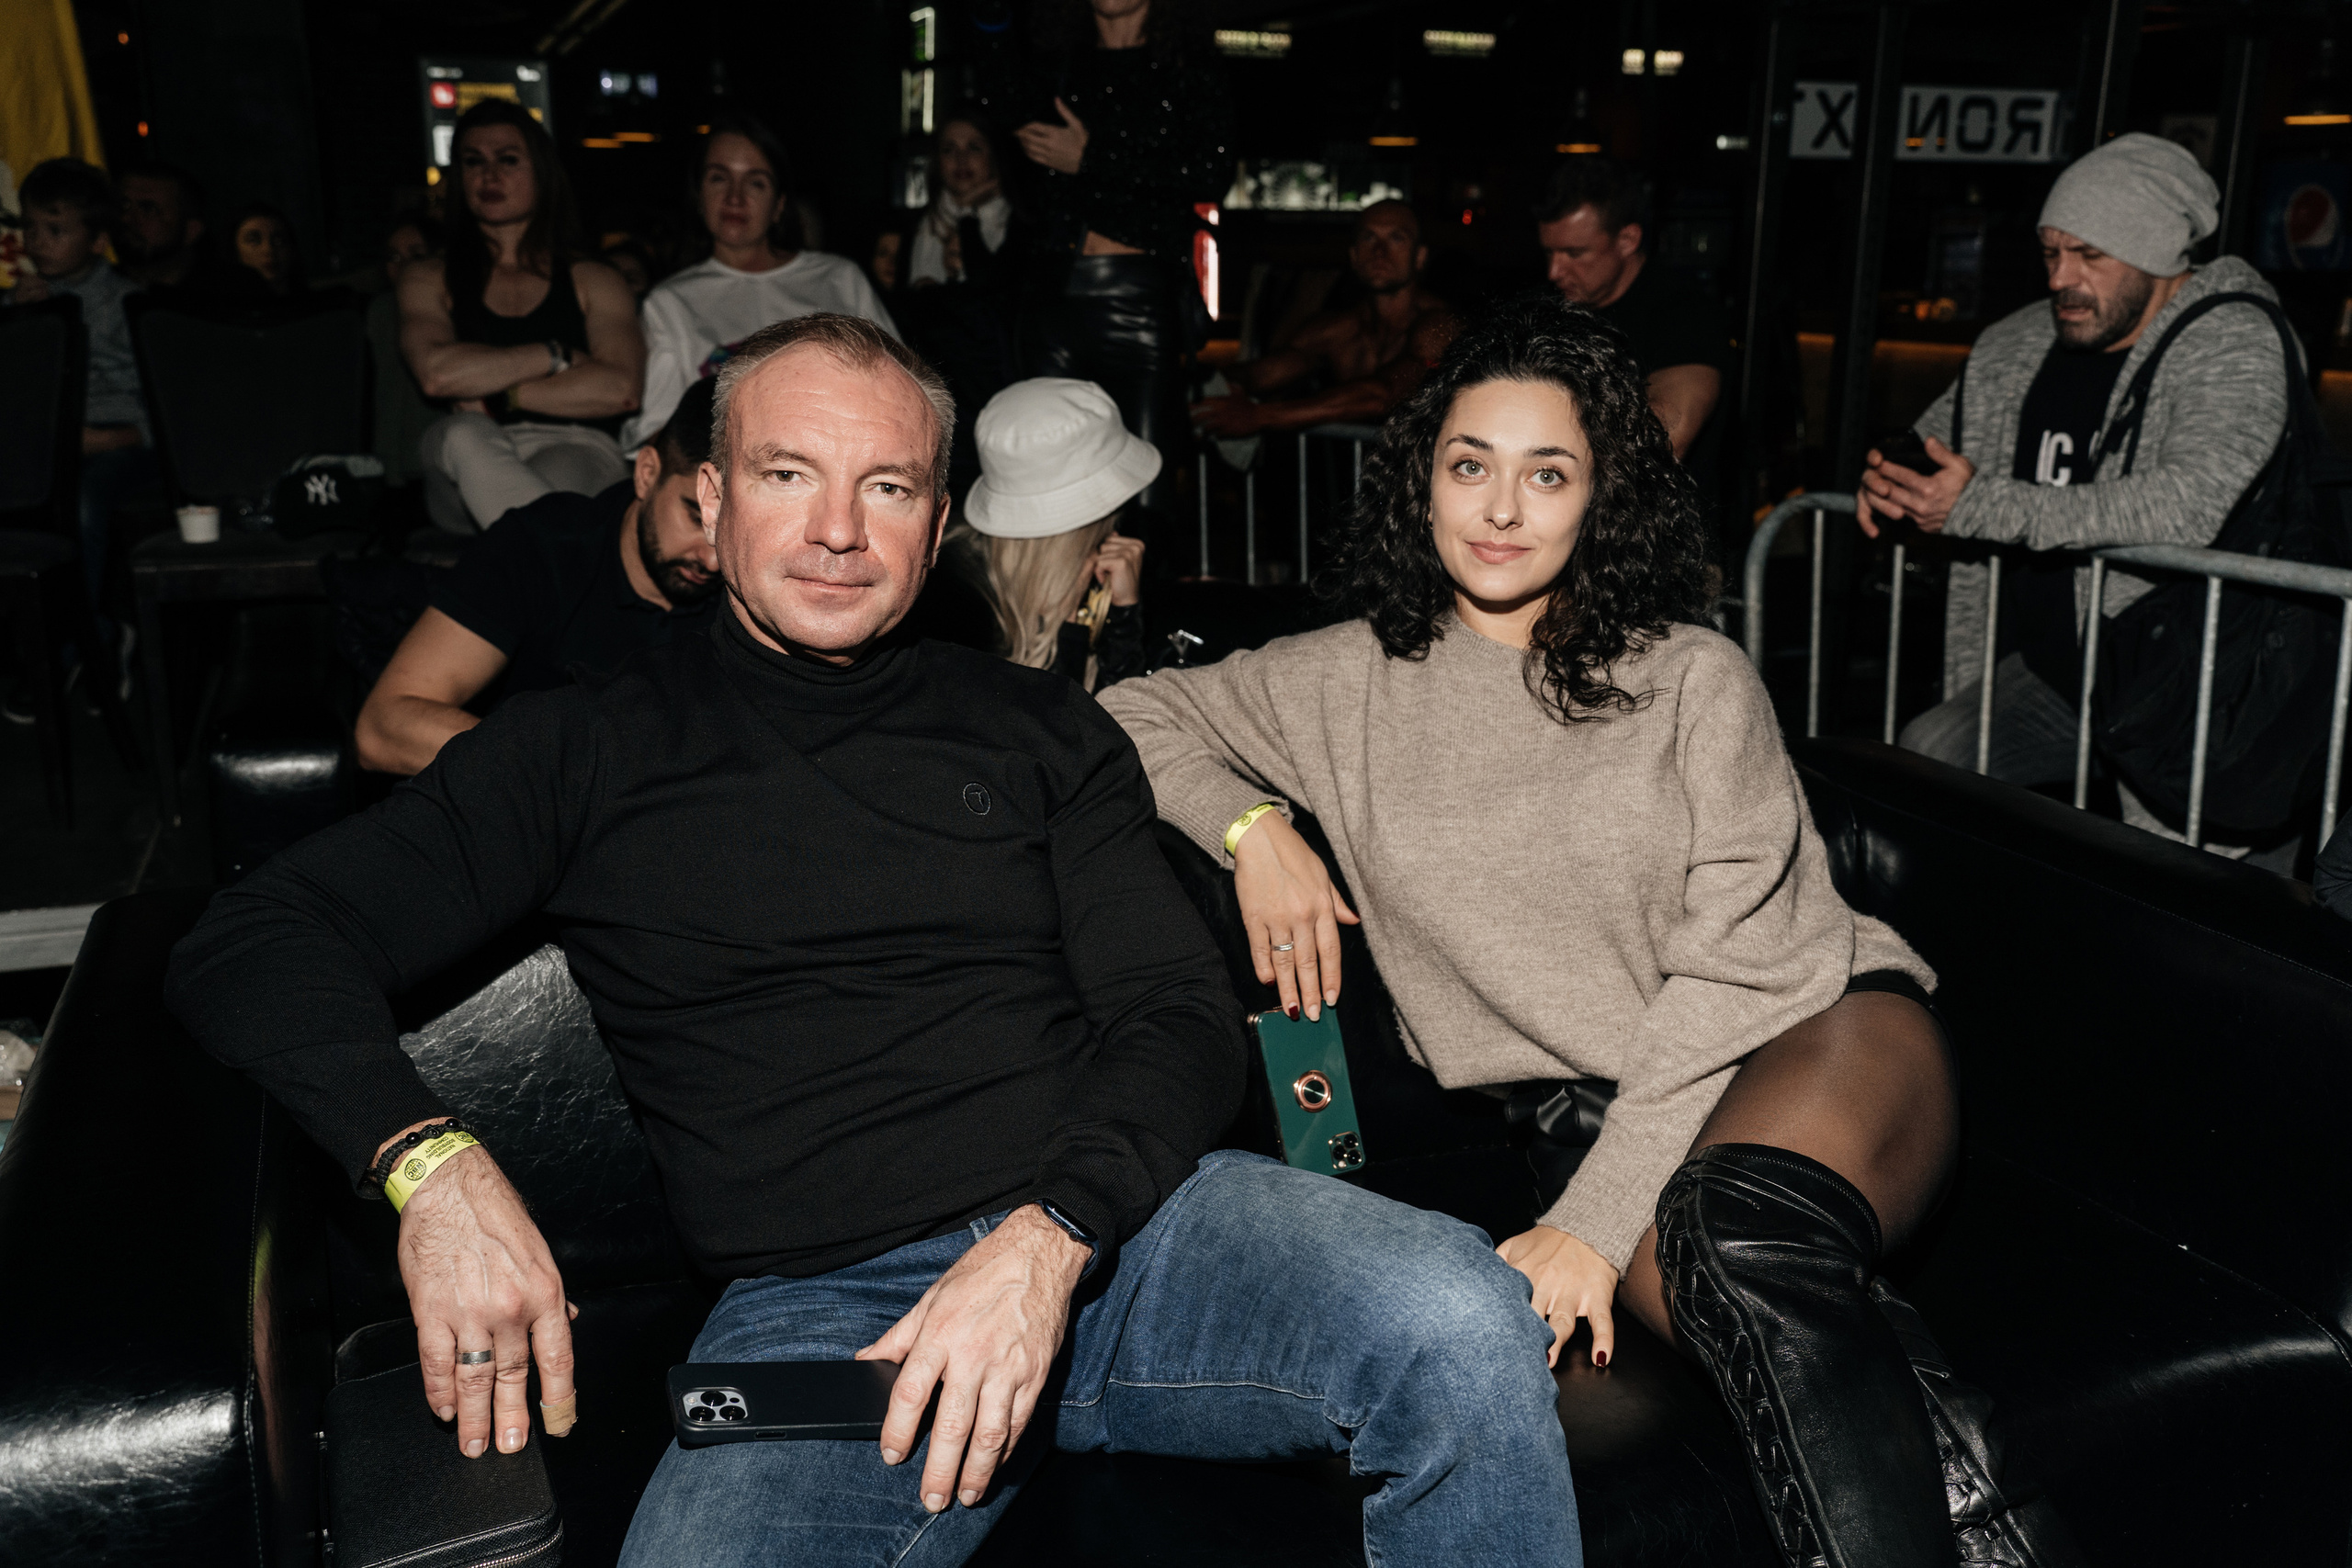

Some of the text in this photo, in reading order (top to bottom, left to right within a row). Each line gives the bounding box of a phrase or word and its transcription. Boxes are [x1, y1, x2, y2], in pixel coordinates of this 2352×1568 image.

[424, 1136, 449, 1154] COMMUNITY
[426, 1138, 457, 1159] BODYBUILDING
[436, 1145, 457, 1158] NATIONAL
[408, 1161, 424, 1178] NBC
